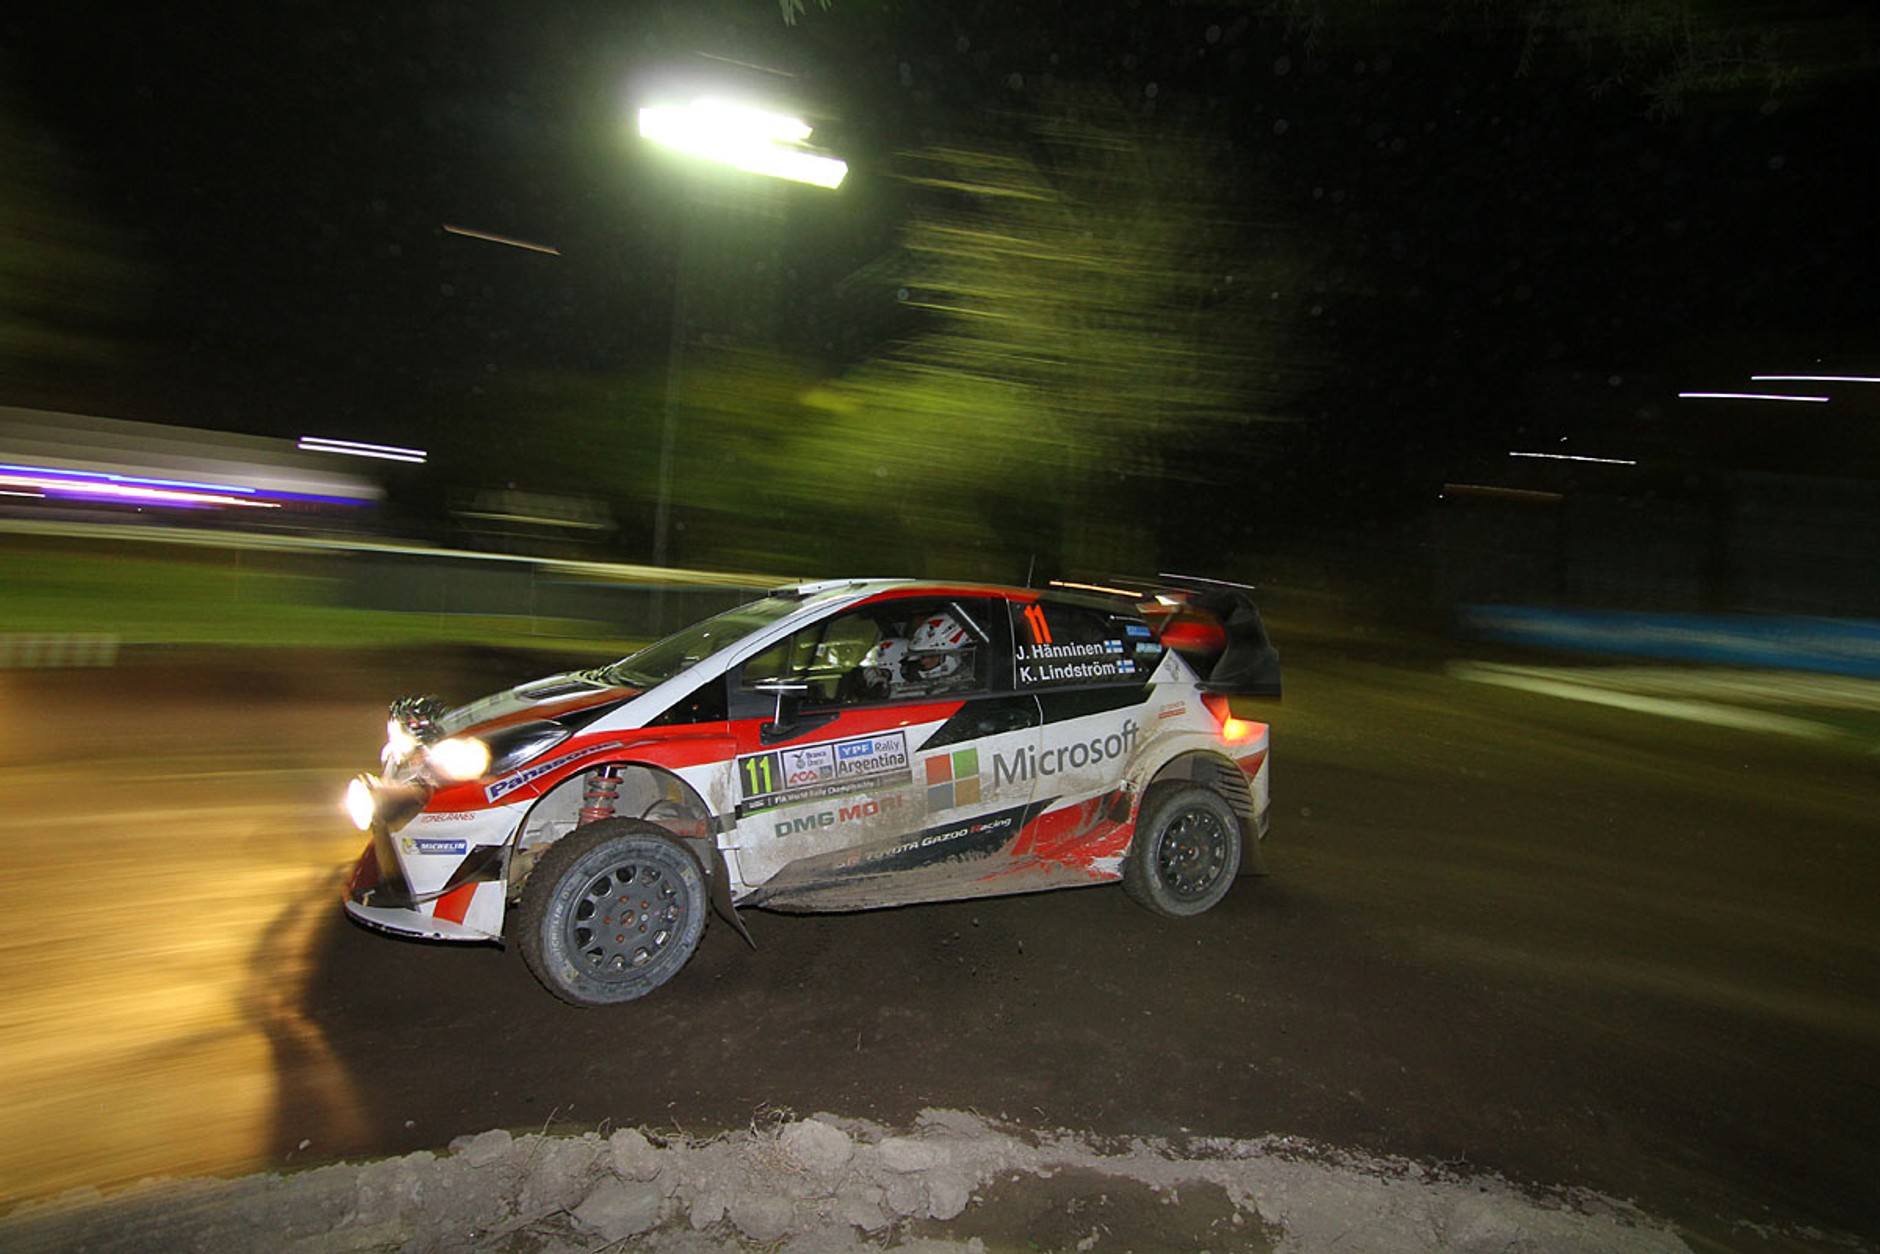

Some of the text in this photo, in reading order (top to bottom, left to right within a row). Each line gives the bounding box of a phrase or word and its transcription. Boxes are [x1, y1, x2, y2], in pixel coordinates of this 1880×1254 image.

[1024, 604, 1053, 644] 11
[1016, 641, 1104, 660] J. Hänninen
[1020, 661, 1116, 682] K. Lindström
[842, 740, 900, 756] YPF Rally
[993, 719, 1140, 788] Microsoft
[490, 741, 620, 798] Panasonic
[746, 756, 773, 795] 11
[838, 752, 905, 775] Argentina
[775, 811, 835, 839] DMG
[921, 828, 968, 847] GAZOO
[969, 817, 1012, 833] Racing
